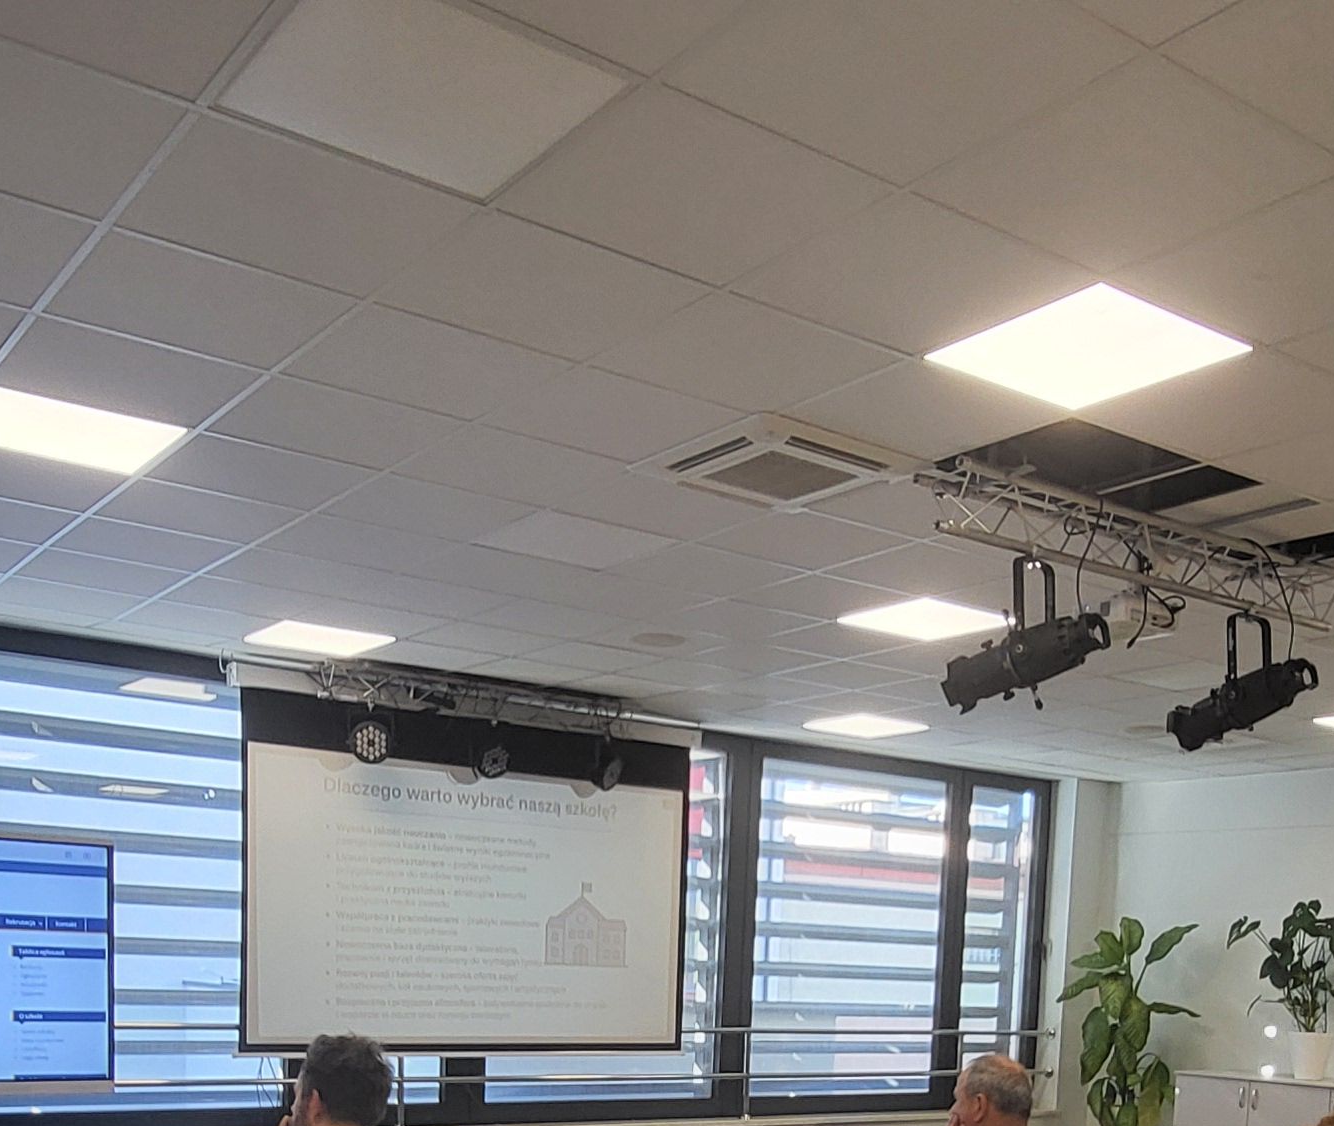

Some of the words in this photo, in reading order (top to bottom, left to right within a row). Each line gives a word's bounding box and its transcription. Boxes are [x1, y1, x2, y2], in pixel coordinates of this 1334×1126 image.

[323, 776, 402, 801] Dlaczego
[405, 785, 453, 804] warto
[457, 790, 514, 810] wybrać
[518, 798, 562, 818] naszą
